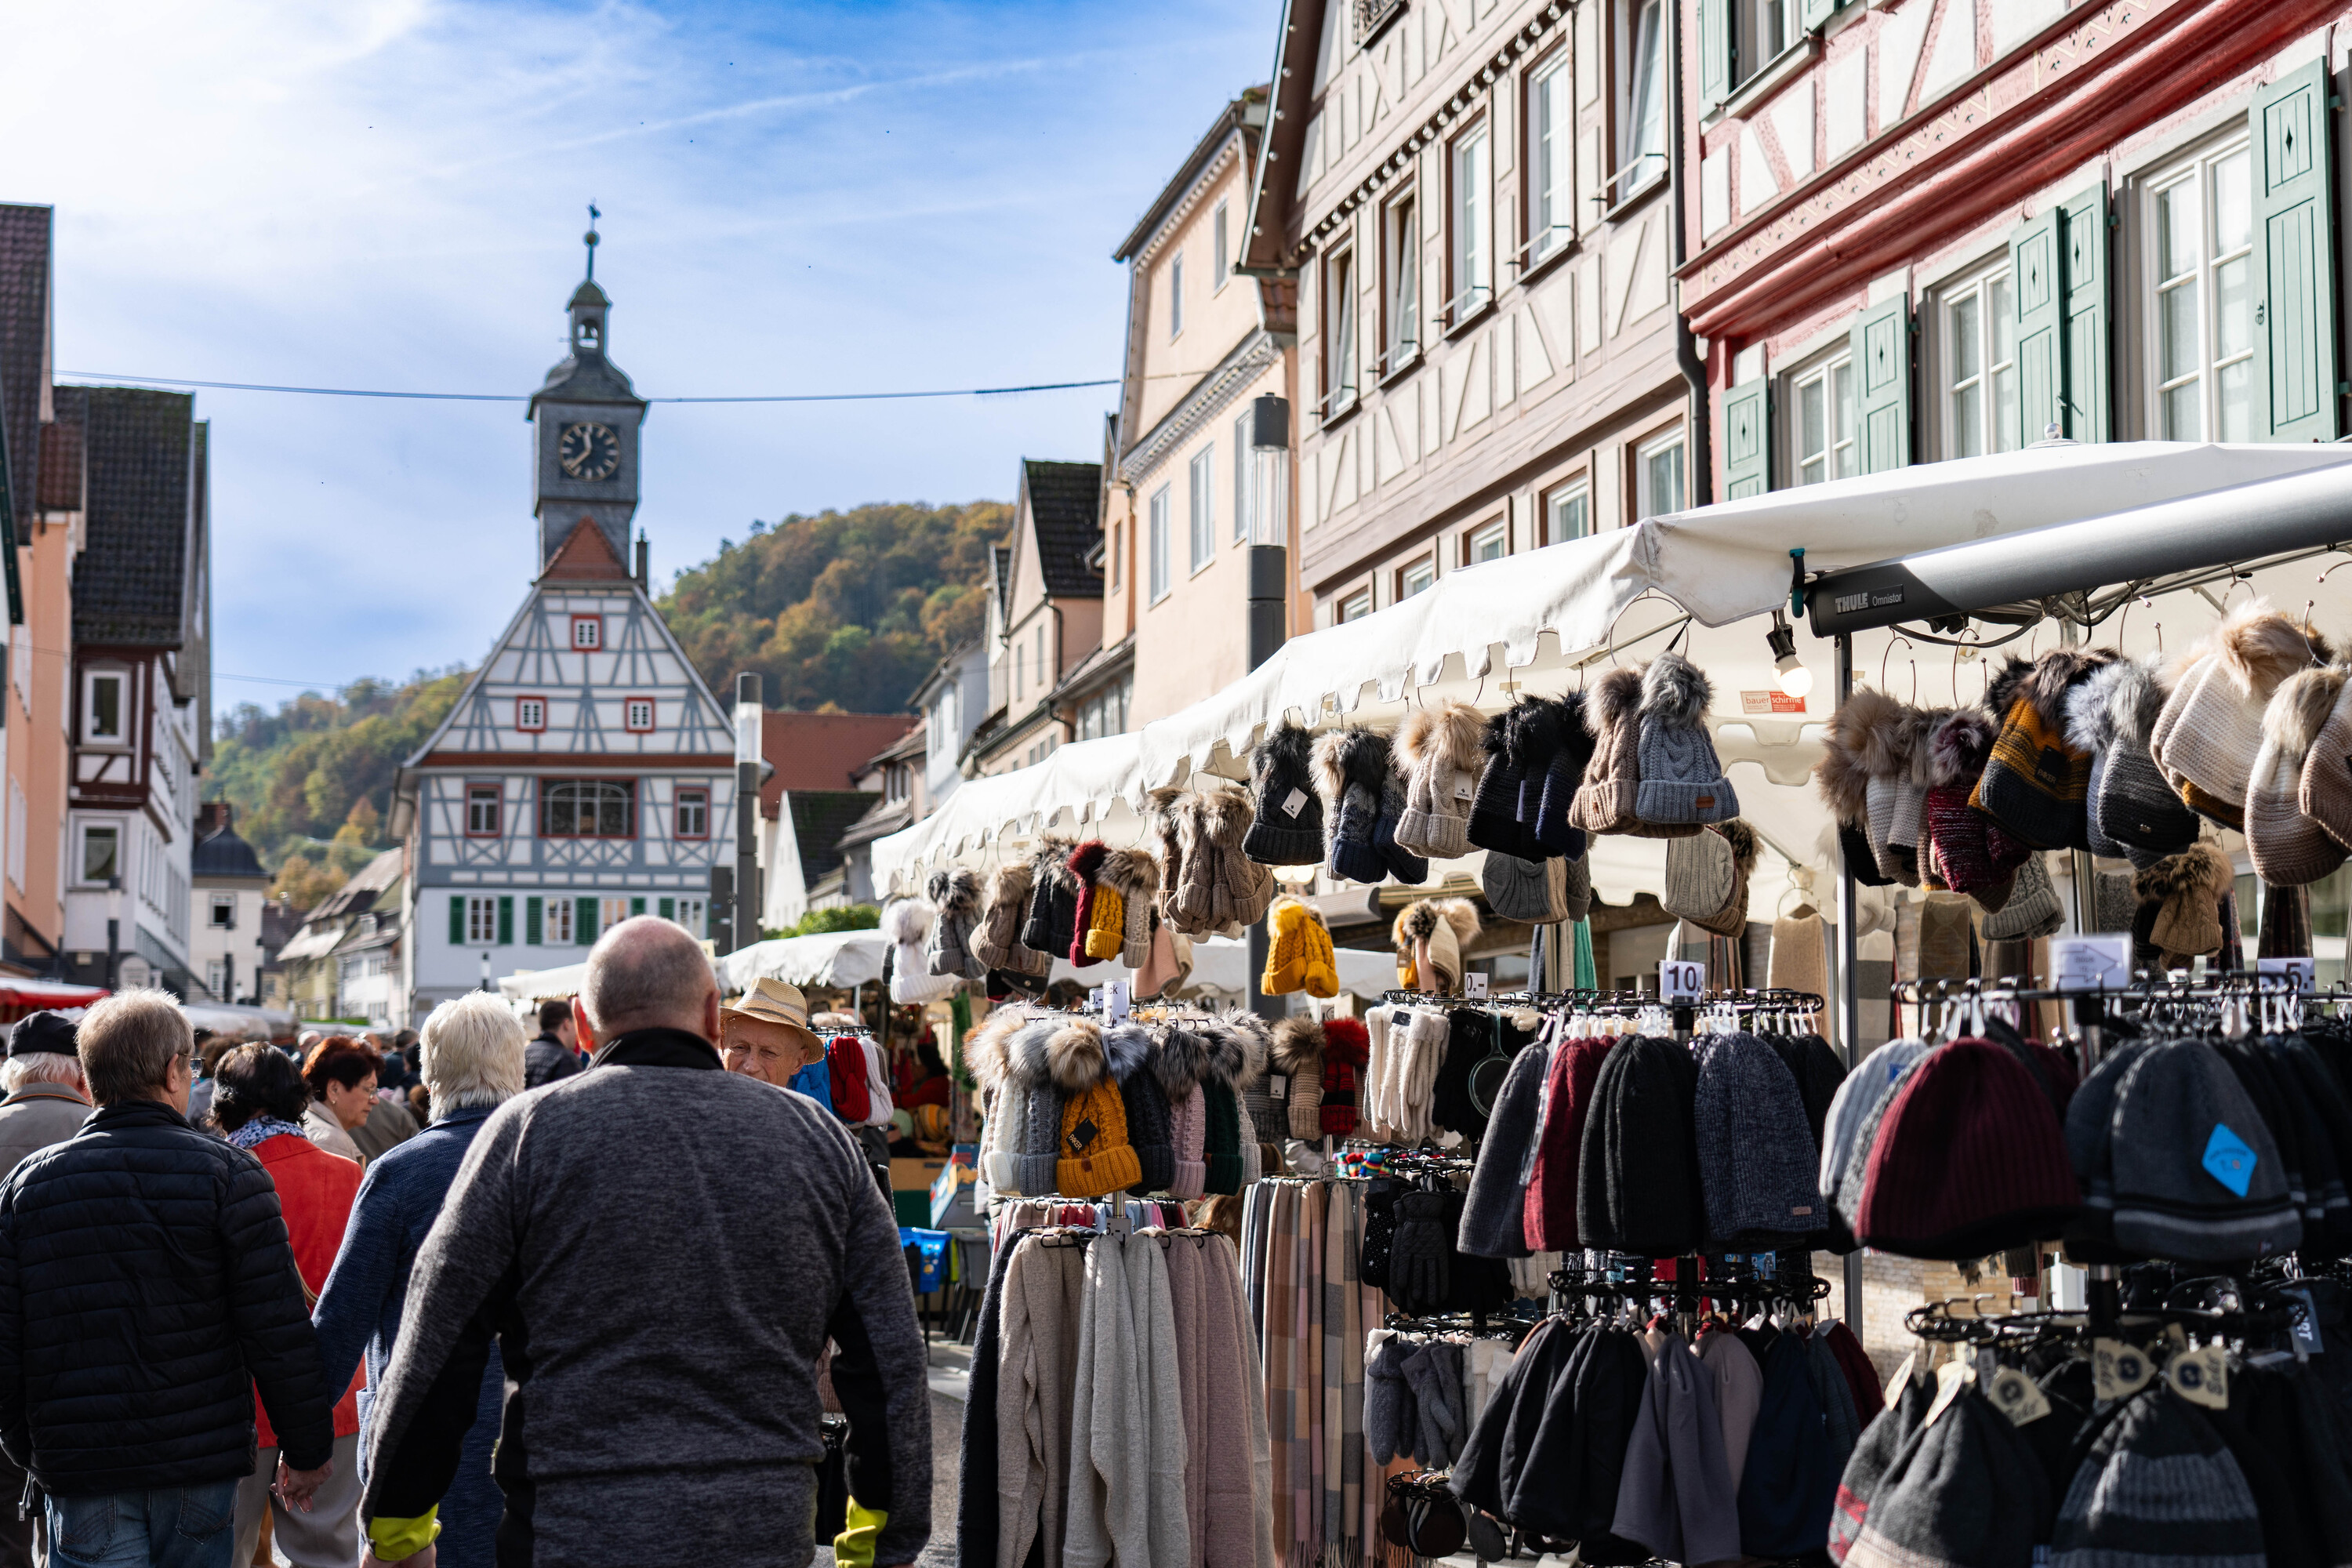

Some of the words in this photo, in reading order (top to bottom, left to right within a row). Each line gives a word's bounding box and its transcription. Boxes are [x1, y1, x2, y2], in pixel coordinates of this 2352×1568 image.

[1835, 593, 1868, 612] THULE
[1872, 593, 1903, 606] Omnistor
[1745, 696, 1769, 705] bauer
[1772, 695, 1802, 704] schirme
